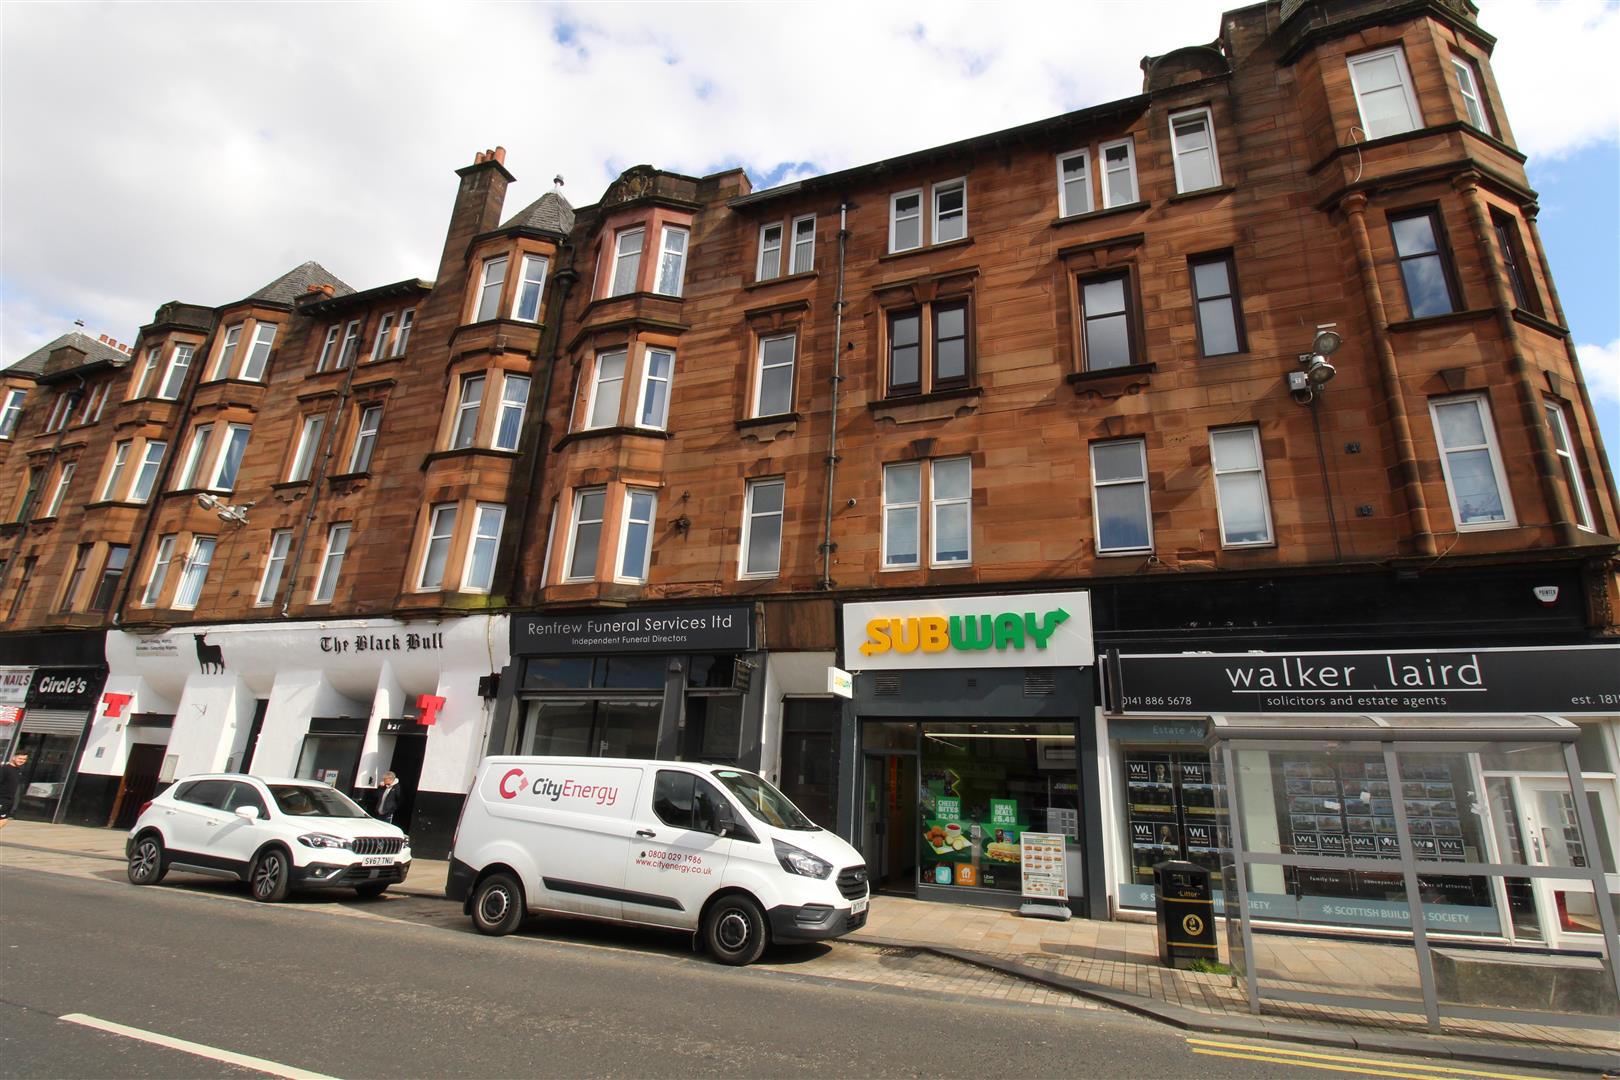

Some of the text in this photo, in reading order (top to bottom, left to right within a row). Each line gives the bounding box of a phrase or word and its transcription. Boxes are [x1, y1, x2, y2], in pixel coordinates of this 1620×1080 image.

[528, 615, 733, 635] Renfrew Funeral Services ltd
[859, 608, 1071, 656] SUBWAY
[320, 632, 444, 654] The Black Bull
[571, 634, 687, 646] Independent Funeral Directors
[1225, 655, 1482, 687] walker laird
[3, 675, 30, 686] NAILS
[39, 676, 87, 694] Circle's
[1145, 696, 1164, 705] 886
[1167, 696, 1192, 706] 5678
[1267, 695, 1447, 708] solicitors and estate agents
[1571, 695, 1596, 705] est.
[1152, 725, 1186, 735] Estate
[1130, 764, 1147, 773] WL
[1184, 766, 1201, 775] WL
[532, 778, 618, 805] CityEnergy
[1135, 825, 1152, 834] WL
[1189, 828, 1207, 837] WL
[1297, 835, 1315, 843] WL
[1322, 836, 1341, 844] WL
[1354, 838, 1374, 846] WL
[1441, 841, 1461, 849] WL
[648, 850, 702, 864] 0800 029 1986
[635, 859, 712, 875] www.cityenergy.co.uk
[1335, 906, 1380, 917] SCOTTISH
[1428, 912, 1471, 923] SOCIETY
